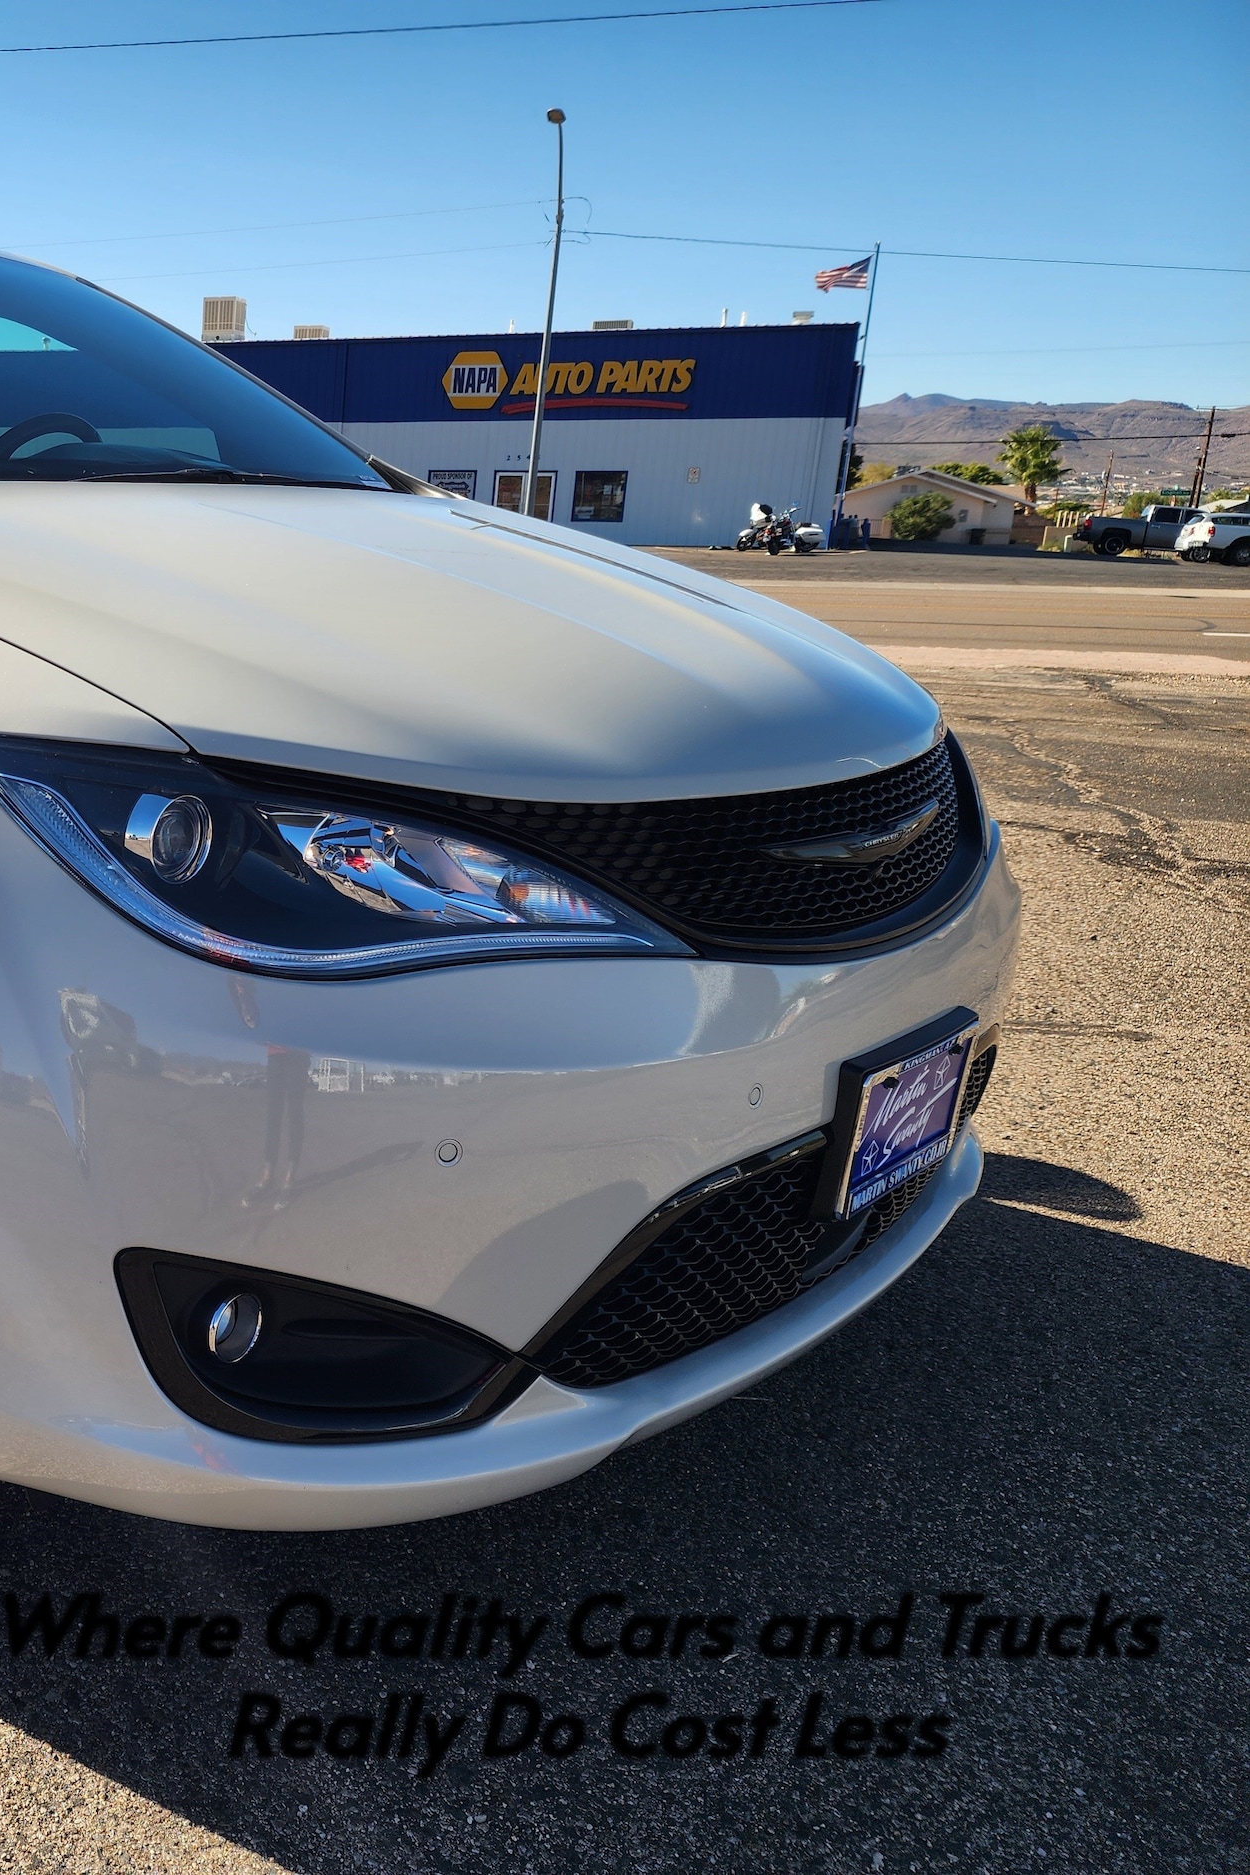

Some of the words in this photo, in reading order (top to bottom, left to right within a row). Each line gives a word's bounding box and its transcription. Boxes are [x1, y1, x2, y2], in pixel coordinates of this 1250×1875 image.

[452, 367, 498, 394] NAPA
[509, 361, 594, 395] AUTO
[595, 358, 696, 394] PARTS
[865, 833, 900, 847] CHRYSLER
[851, 1177, 888, 1212] MARTIN
